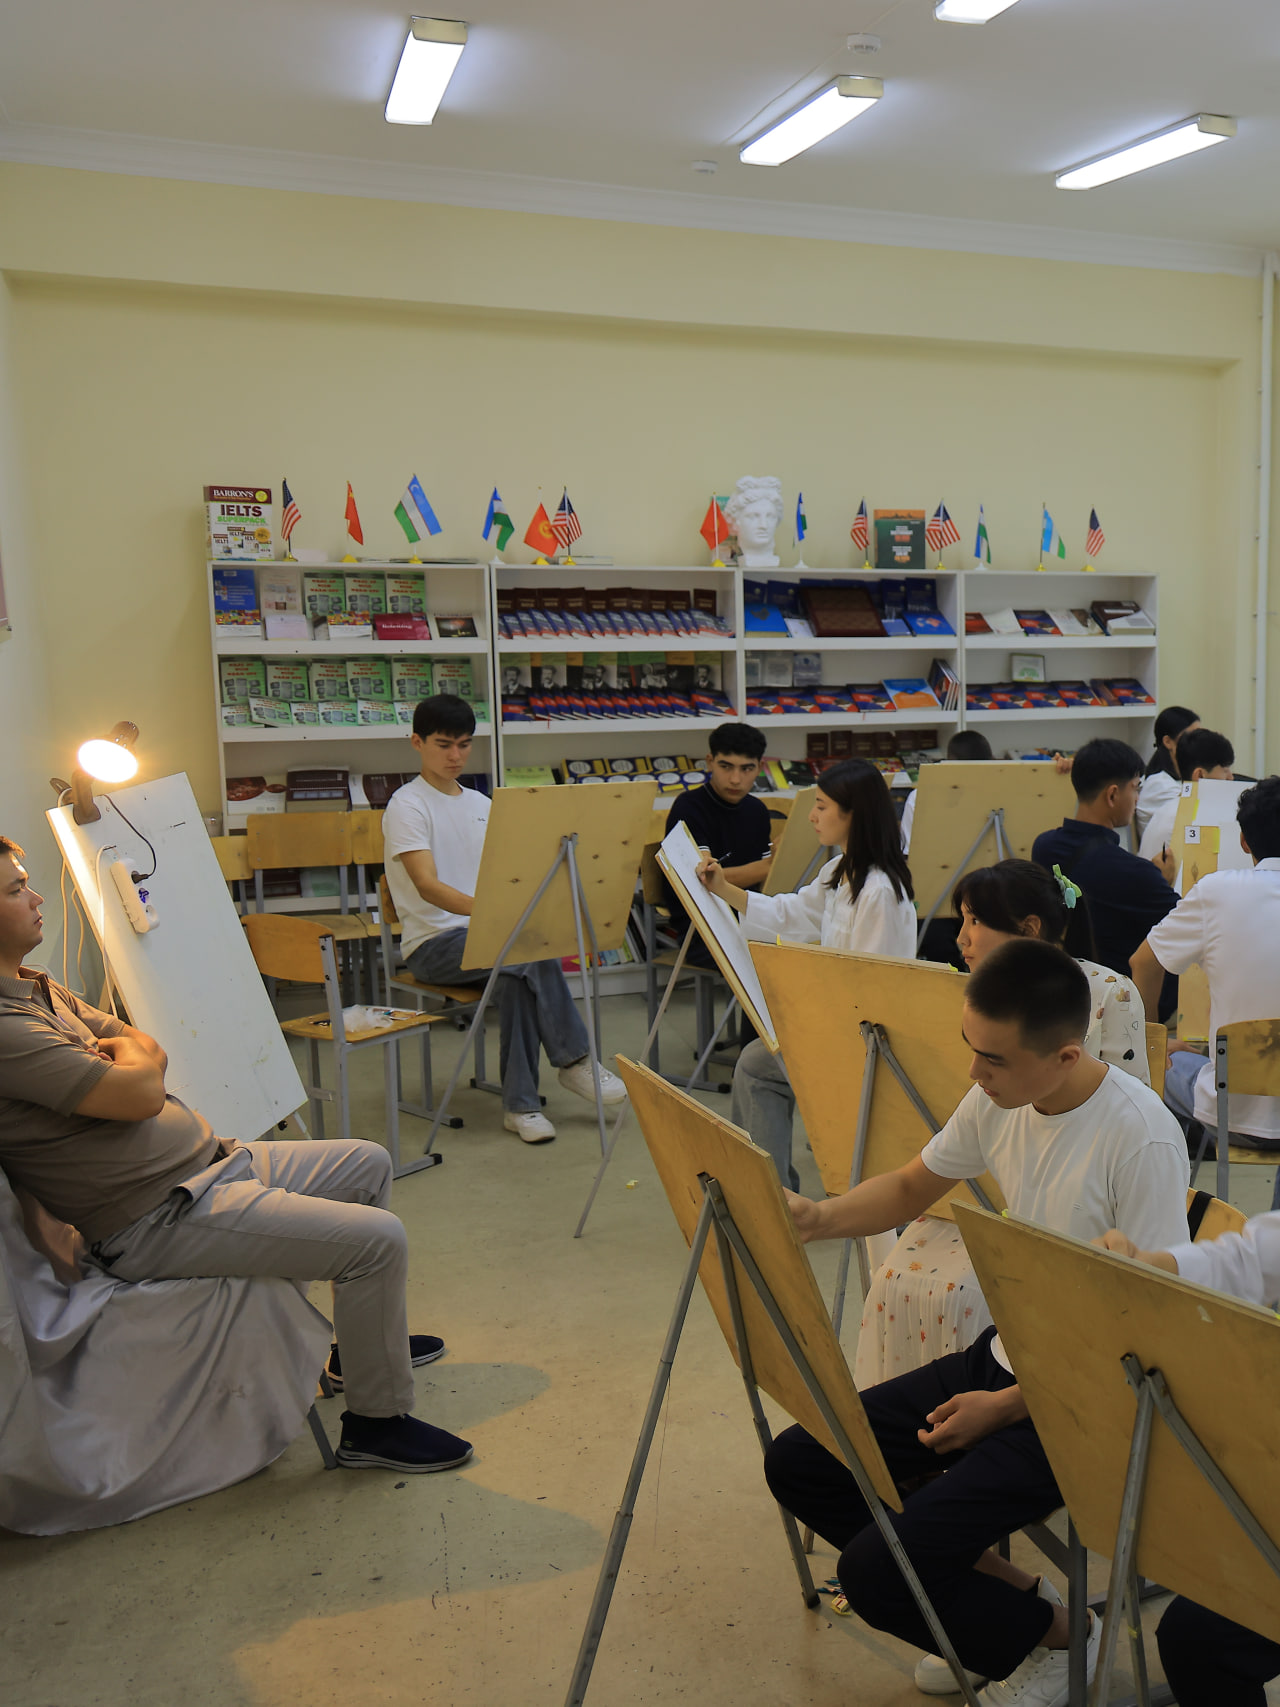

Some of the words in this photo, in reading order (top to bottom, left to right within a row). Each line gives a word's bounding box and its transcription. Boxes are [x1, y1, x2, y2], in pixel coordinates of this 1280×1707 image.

[213, 489, 254, 497] BARRON'S
[221, 504, 262, 517] IELTS
[1189, 829, 1196, 837] 3
